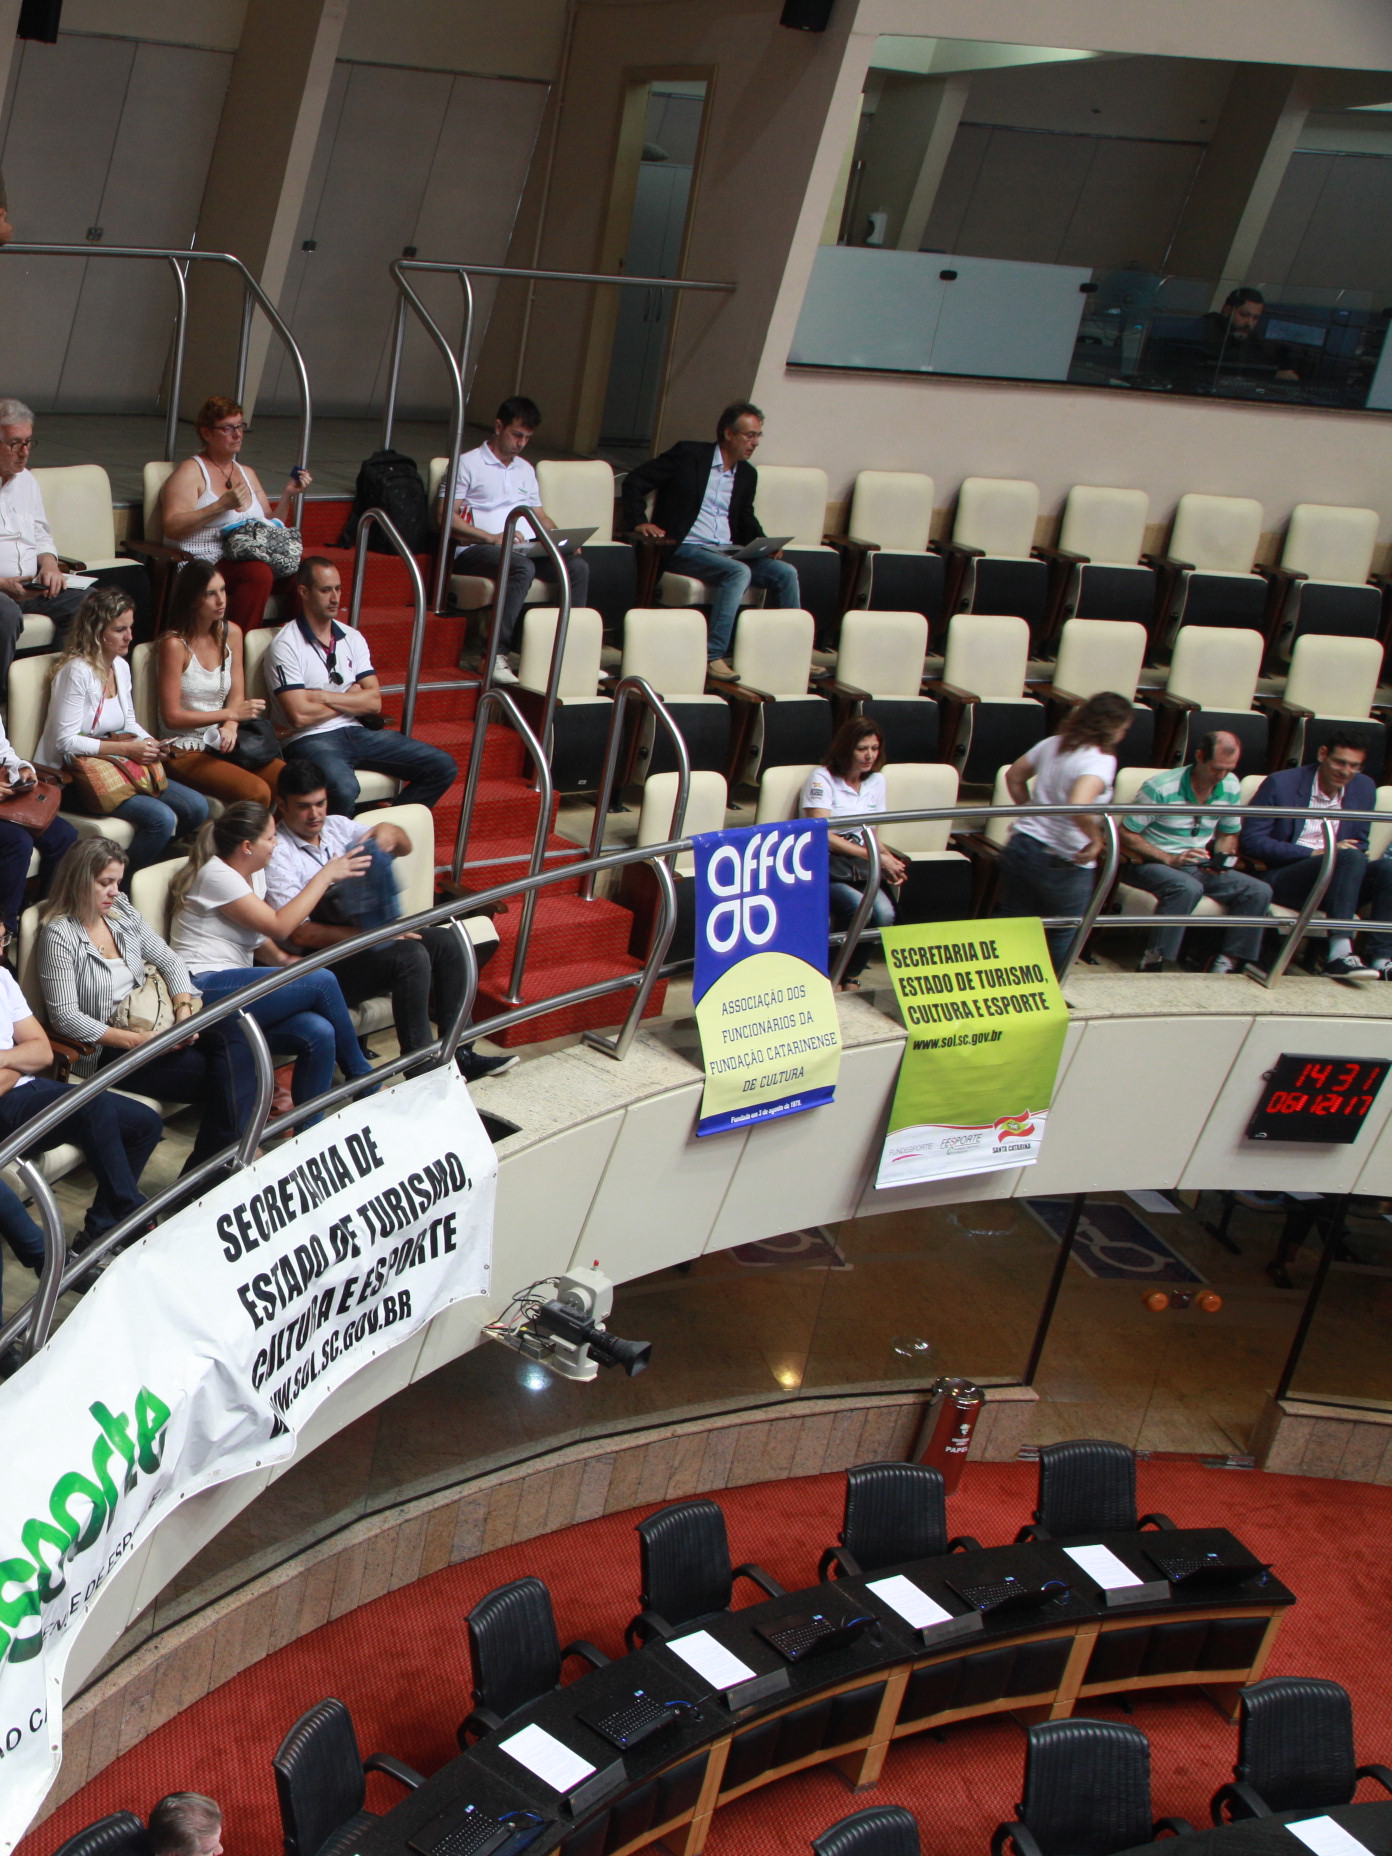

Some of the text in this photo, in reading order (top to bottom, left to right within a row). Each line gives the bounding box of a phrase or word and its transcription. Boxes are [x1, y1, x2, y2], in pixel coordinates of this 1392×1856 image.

[891, 940, 999, 969] SECRETARIA DE
[898, 964, 1048, 997] ESTADO DE TURISMO,
[721, 985, 806, 1016] ASSOCIAÇÃO DOS
[907, 991, 1050, 1025] CULTURA E ESPORTE
[722, 1011, 814, 1043] FUNCIONÁRIOS DA
[912, 1029, 1003, 1051] www.sol.sc.gov.br
[709, 1032, 837, 1075] FUNDAÇÃO CATARINENSE
[742, 1066, 805, 1092] DE CULTURA
[216, 1125, 384, 1263] SECRETARIA DE
[236, 1151, 473, 1331] ESTADO DE TURISMO,
[335, 1276, 360, 1316] E
[356, 1211, 457, 1306] ESPORTE
